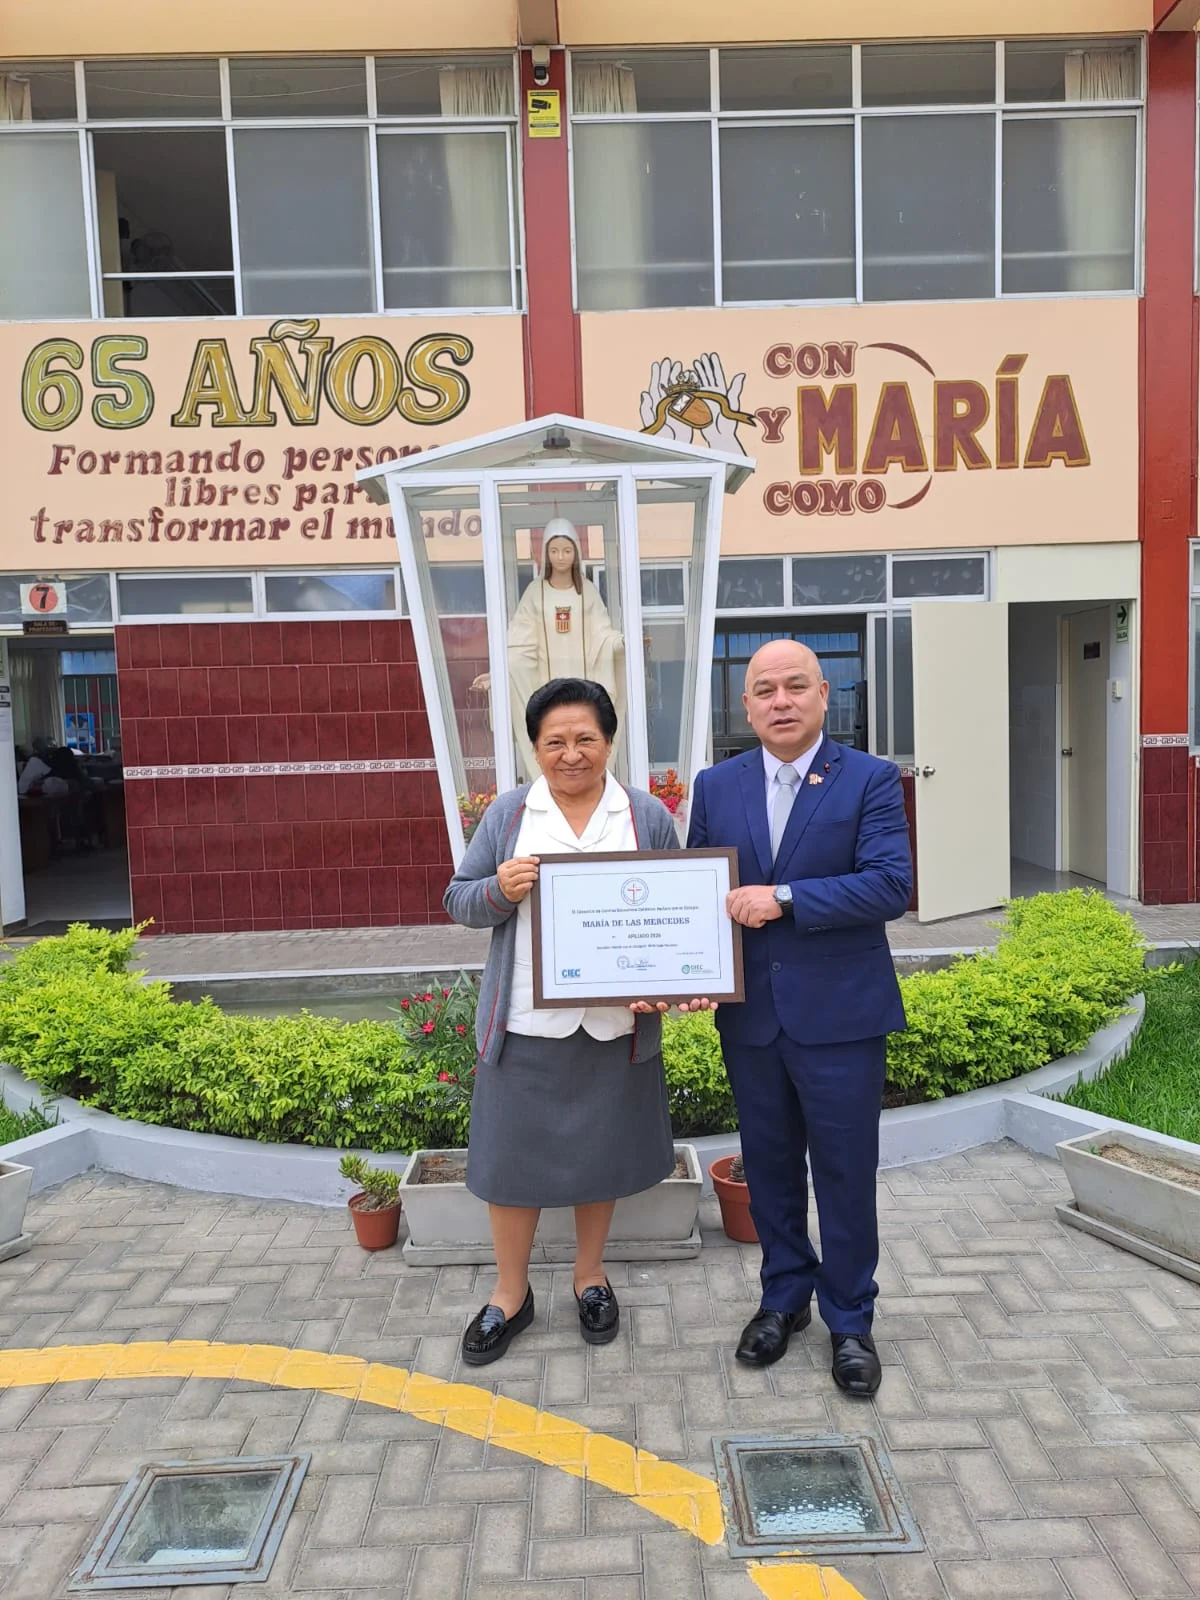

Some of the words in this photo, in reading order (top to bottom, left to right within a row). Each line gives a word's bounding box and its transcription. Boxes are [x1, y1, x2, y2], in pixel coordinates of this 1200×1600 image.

[21, 335, 154, 431] 65
[171, 318, 474, 427] AÑOS
[763, 341, 858, 379] CON
[755, 406, 791, 443] Y
[797, 353, 1091, 475] MARÍA
[47, 439, 266, 475] Formando
[165, 476, 281, 508] libres
[293, 480, 377, 511] par
[763, 479, 886, 516] COMO
[30, 506, 292, 544] transformar
[300, 507, 335, 540] el
[36, 586, 50, 609] 7
[582, 918, 610, 928] MARÍA
[612, 919, 623, 927] DE
[625, 918, 642, 927] LAS
[643, 917, 690, 926] MERCEDES
[561, 968, 581, 978] CIEC
